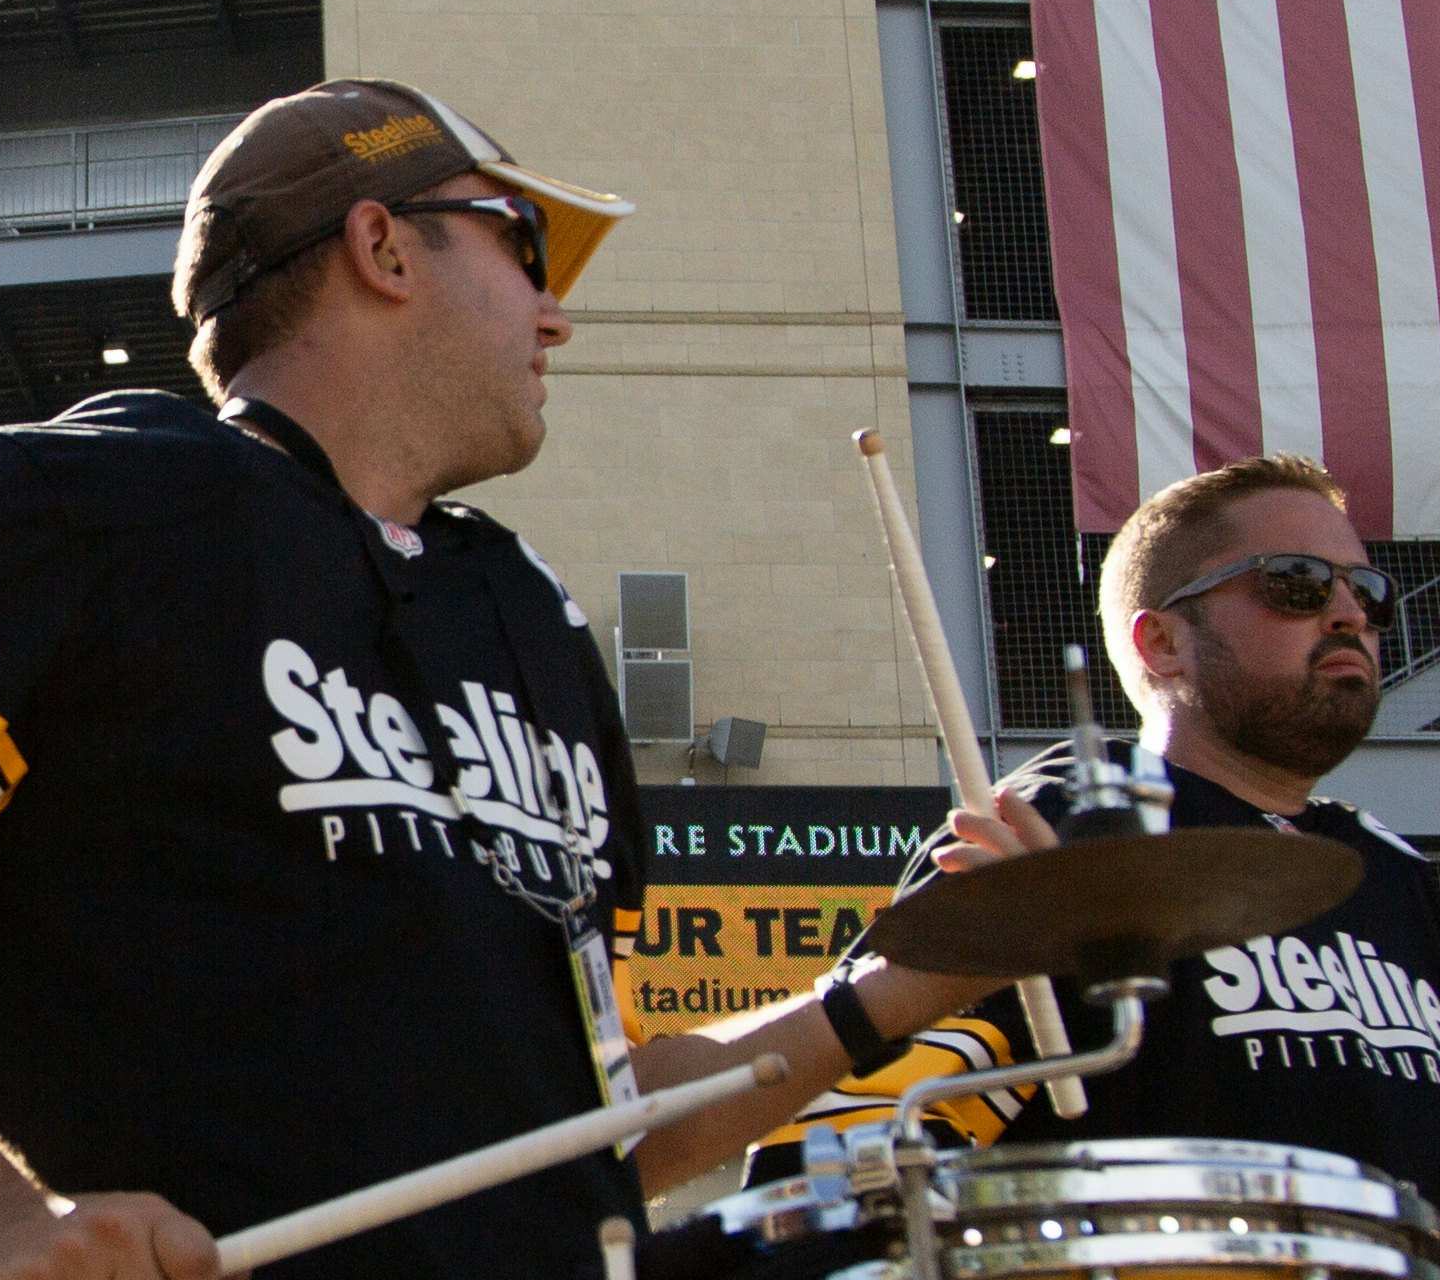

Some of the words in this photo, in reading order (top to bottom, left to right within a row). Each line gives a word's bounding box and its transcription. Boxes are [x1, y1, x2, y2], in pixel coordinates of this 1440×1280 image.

[728, 824, 923, 857] STADIUM
[744, 907, 892, 958] TEA
[634, 978, 791, 1014] tadium
